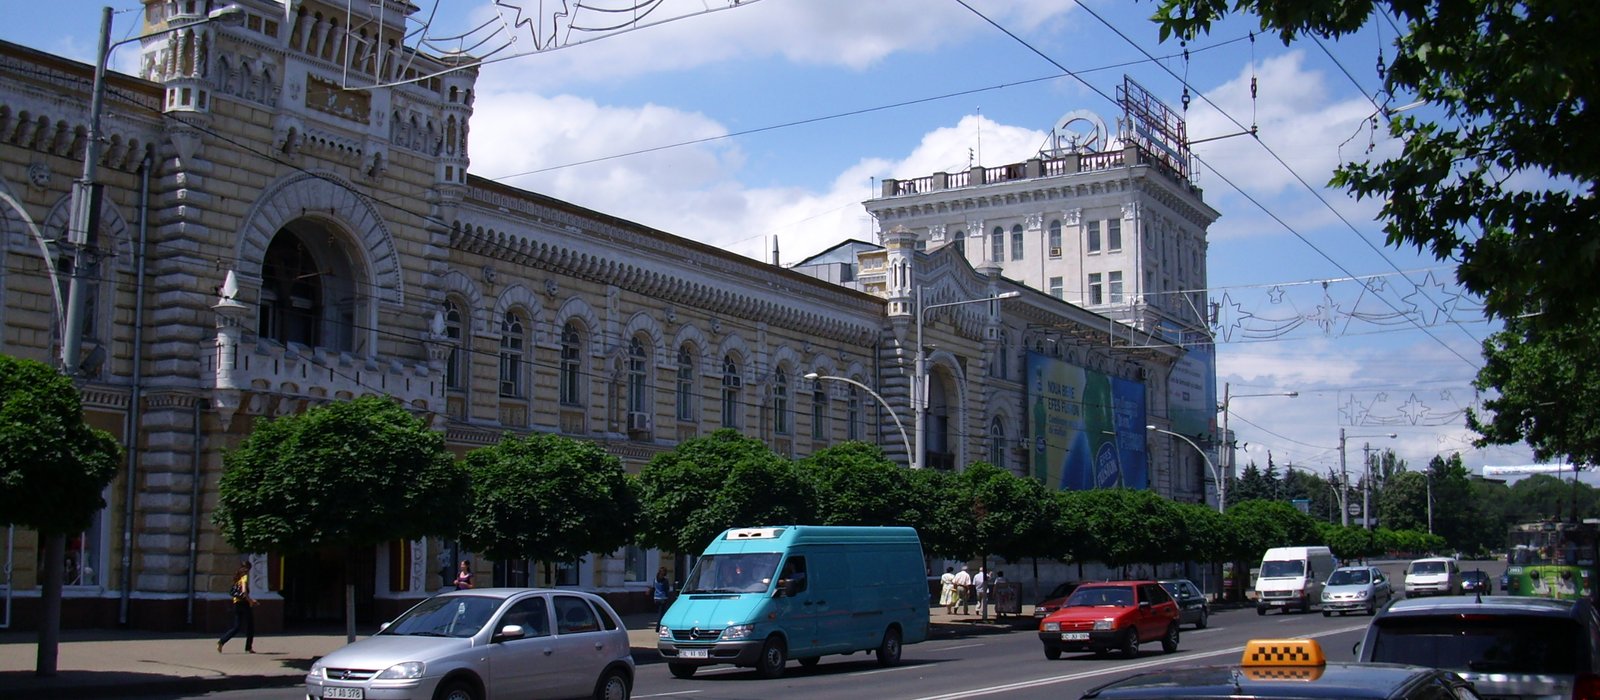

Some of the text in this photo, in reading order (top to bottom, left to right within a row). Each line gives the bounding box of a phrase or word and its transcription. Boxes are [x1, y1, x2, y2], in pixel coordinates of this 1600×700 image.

[1048, 381, 1061, 396] NOUA
[1048, 398, 1061, 412] EFES
[1099, 448, 1111, 466] EFES
[328, 687, 337, 697] ST
[347, 688, 360, 698] 378
